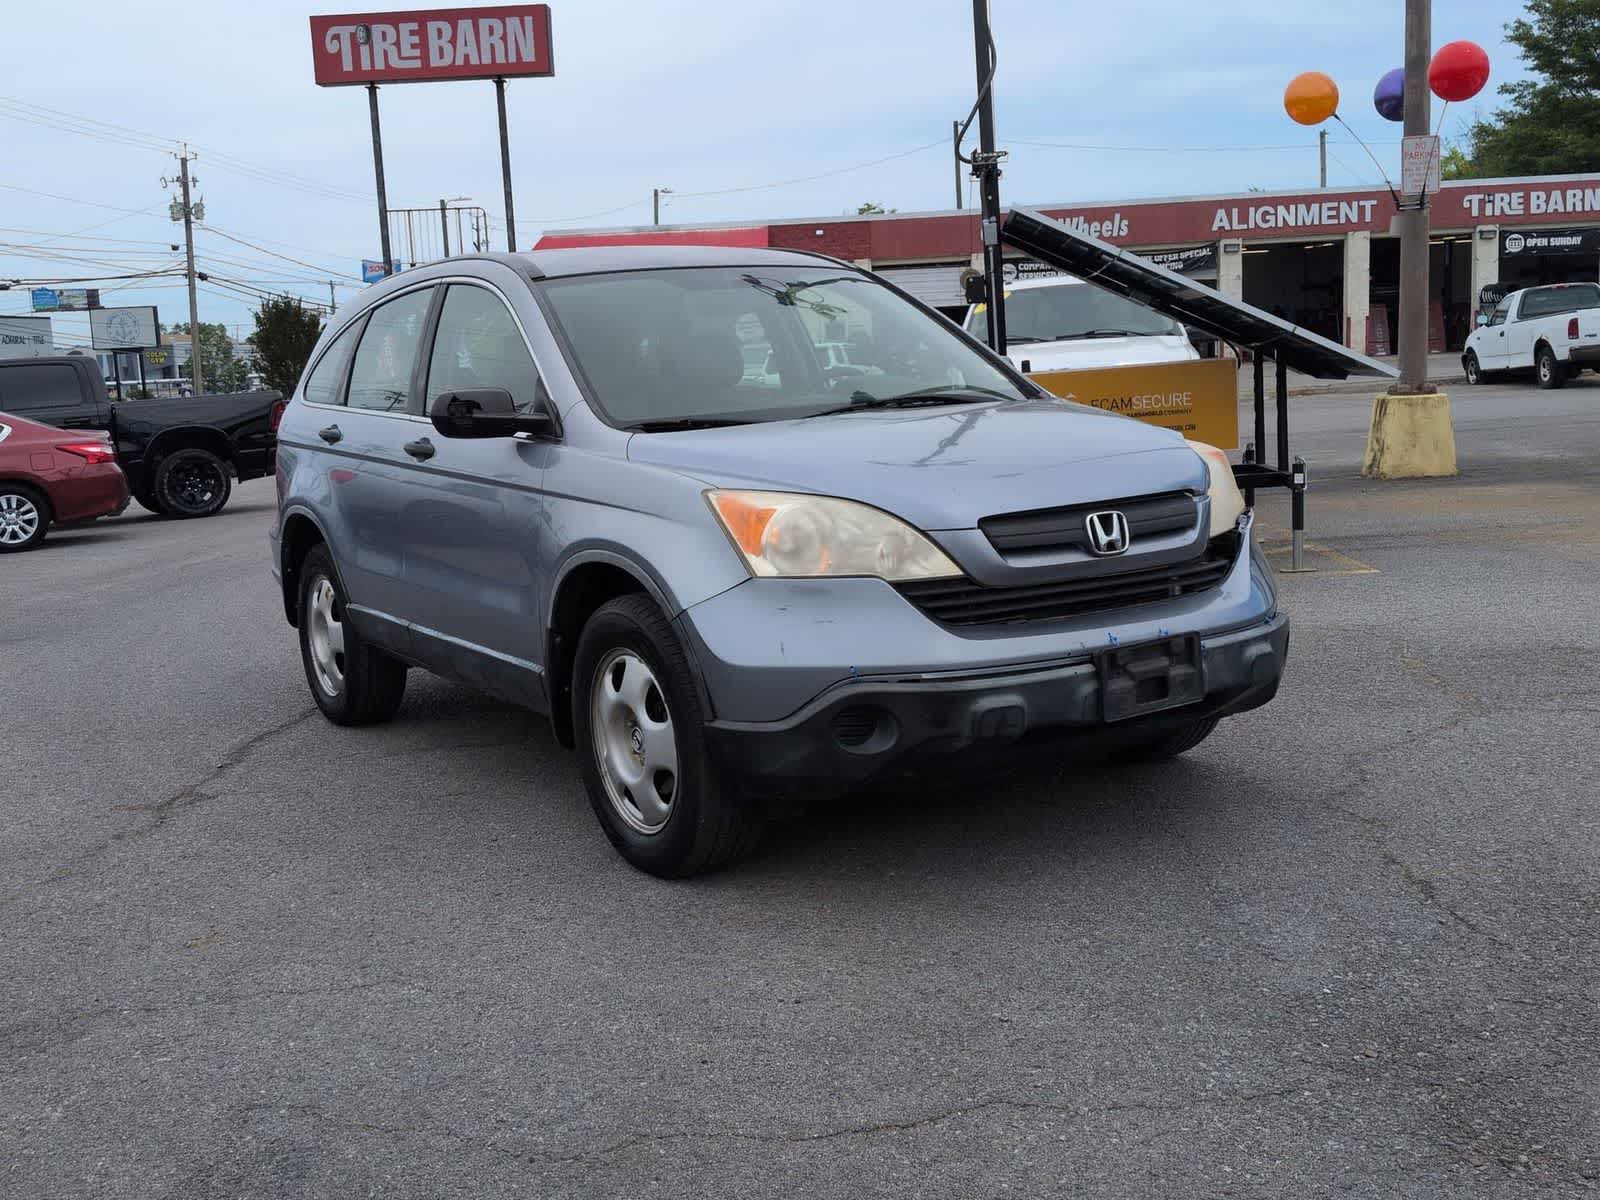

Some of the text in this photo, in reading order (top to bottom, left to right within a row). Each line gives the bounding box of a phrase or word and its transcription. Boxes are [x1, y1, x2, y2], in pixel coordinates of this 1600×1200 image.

[427, 15, 537, 68] BARN
[1530, 187, 1600, 215] BARN
[1211, 199, 1378, 232] ALIGNMENT
[1180, 247, 1212, 259] SPECIAL
[1526, 236, 1582, 247] OPEN SUNDAY
